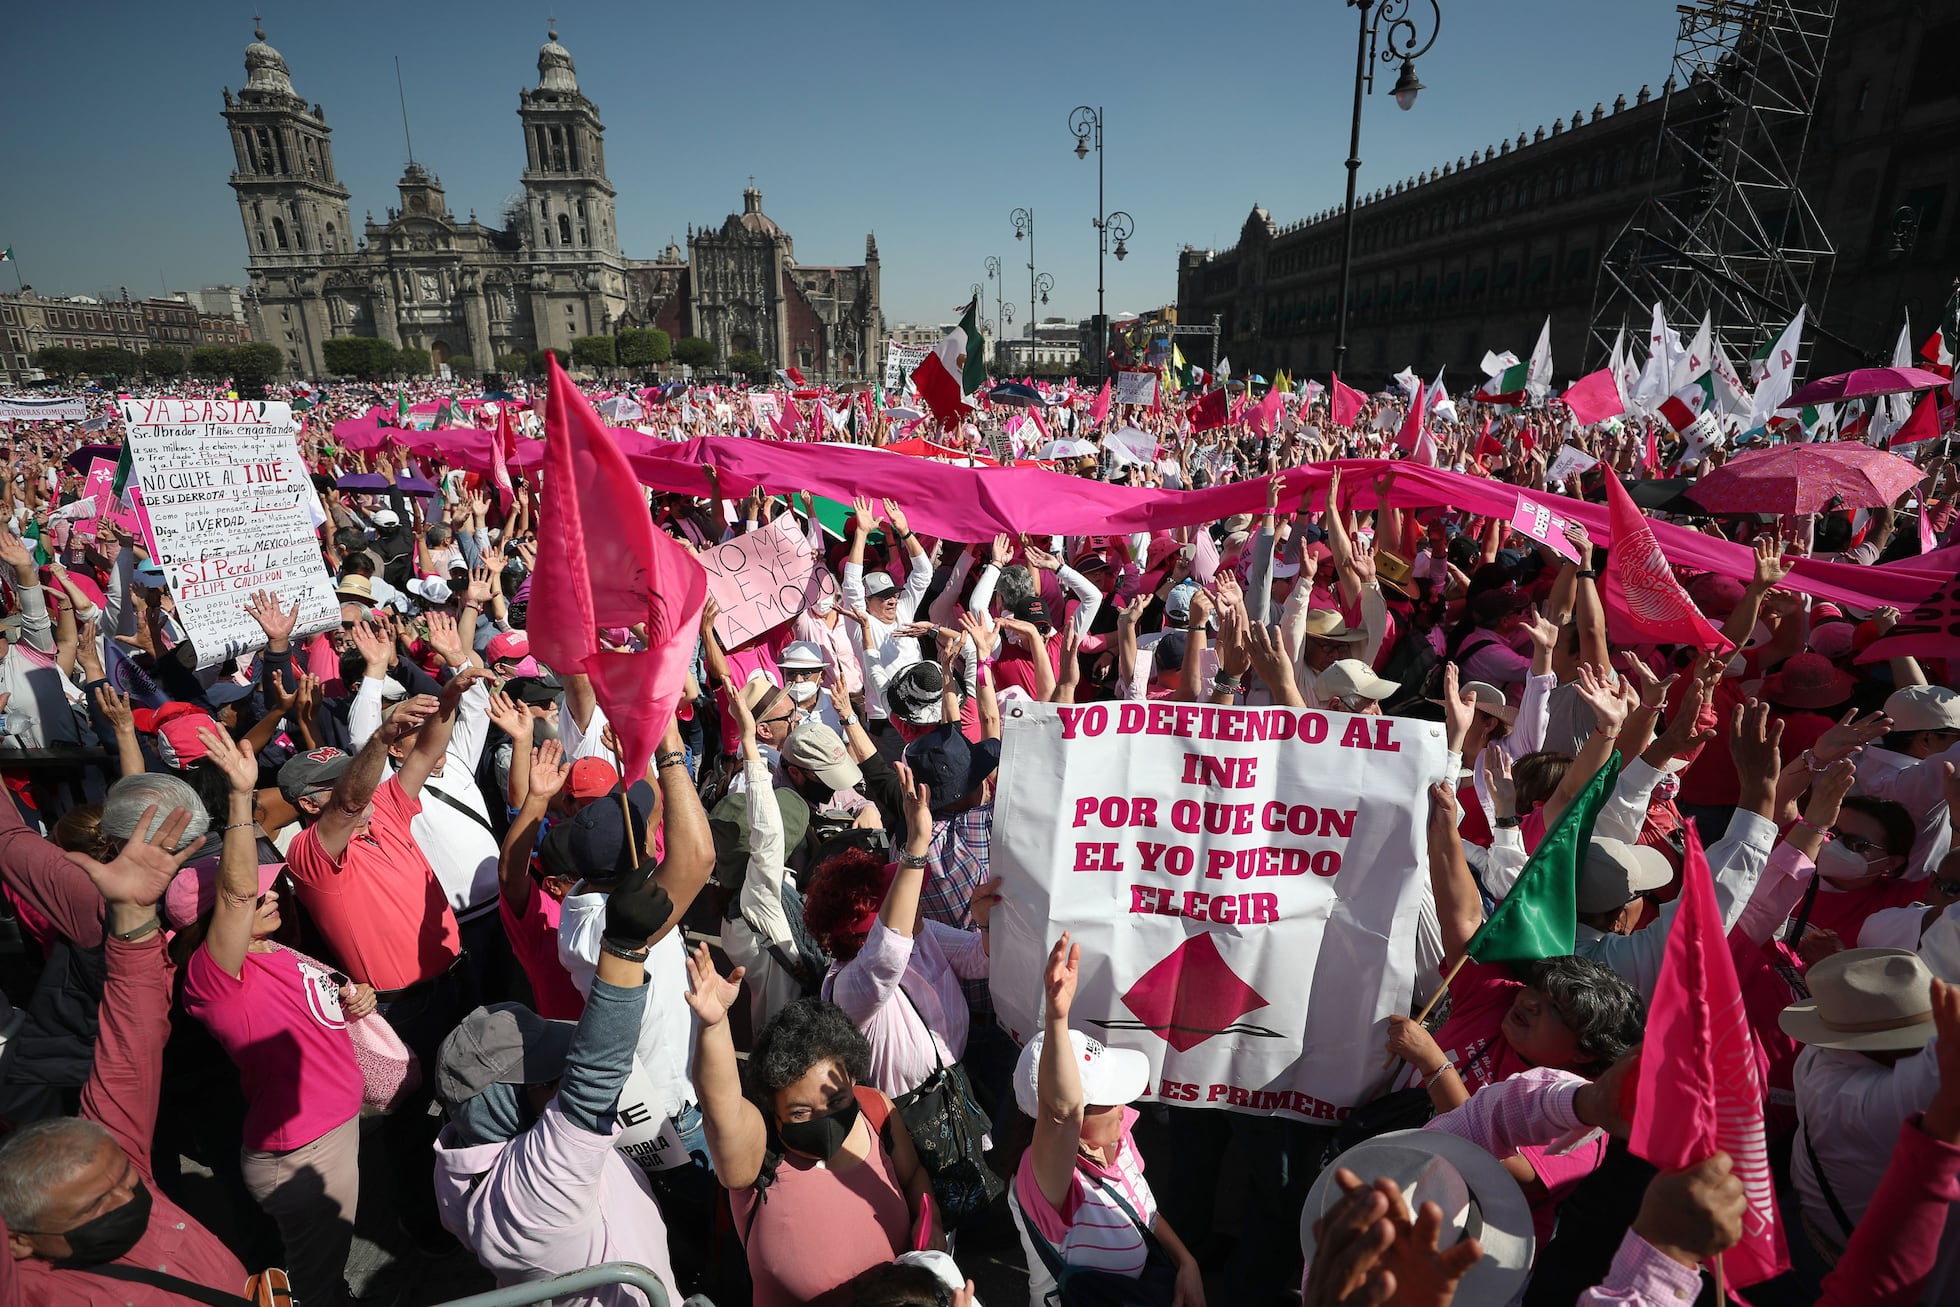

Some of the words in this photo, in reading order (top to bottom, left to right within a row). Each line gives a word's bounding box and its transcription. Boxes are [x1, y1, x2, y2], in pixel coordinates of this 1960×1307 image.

[41, 408, 85, 416] COMUNISTAS
[179, 399, 266, 423] BASTA!
[169, 472, 214, 489] CULPE
[177, 490, 225, 503] DERROTA
[181, 580, 227, 599] FELIPE
[233, 569, 282, 589] CALDERON
[756, 566, 835, 630] MODO
[1056, 706, 1108, 739] YO
[1117, 703, 1329, 744] DEFIENDO
[1340, 716, 1401, 752] AL
[1181, 753, 1257, 789] INE
[1072, 796, 1158, 828] POR
[1171, 799, 1254, 835] QUE
[1261, 801, 1357, 838] CON
[1073, 842, 1124, 872] EL
[1136, 842, 1194, 872] YO
[1205, 847, 1342, 880] PUEDO
[1129, 884, 1279, 925] ELEGIR
[1160, 1079, 1199, 1102] ES
